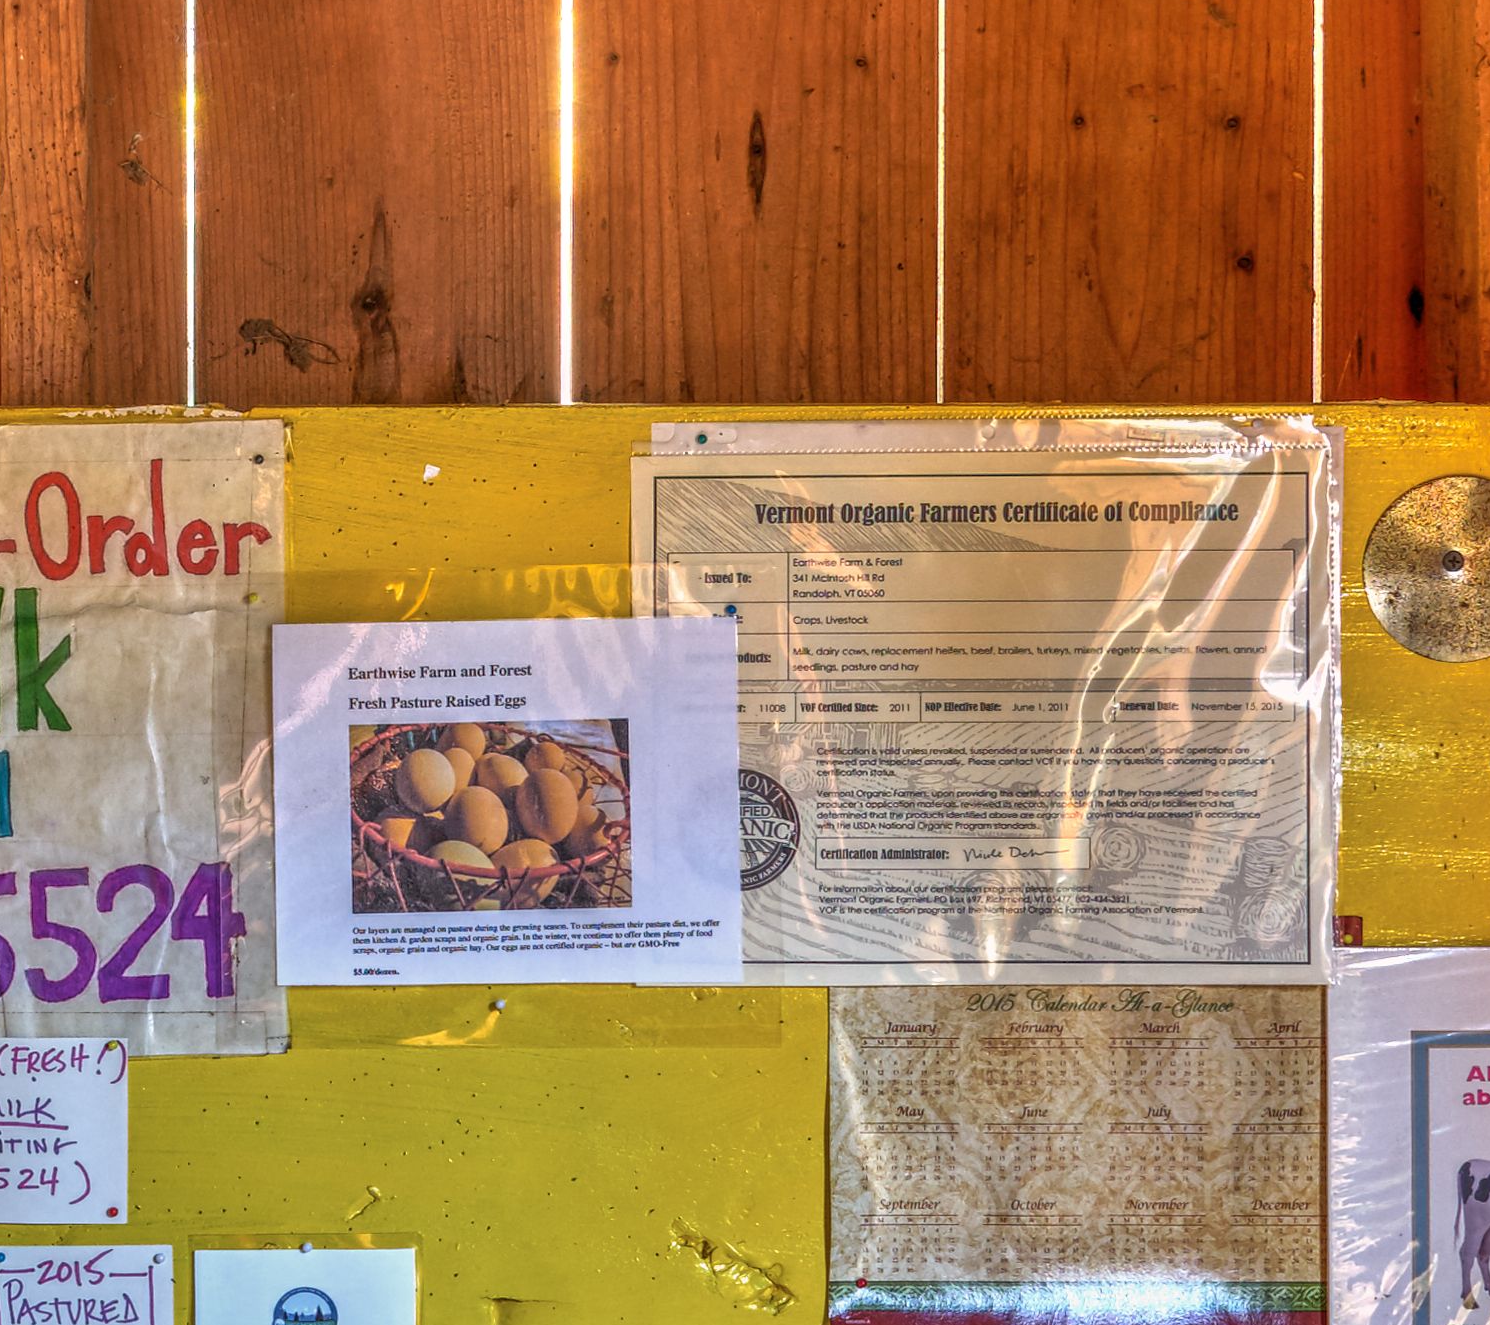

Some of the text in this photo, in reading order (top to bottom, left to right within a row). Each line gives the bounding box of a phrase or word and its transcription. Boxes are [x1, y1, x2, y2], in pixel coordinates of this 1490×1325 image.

[754, 500, 1239, 526] Vermont Organic Farmers Certificate of Compliance
[348, 664, 532, 680] Earthwise Farm and Forest
[348, 694, 527, 711] Fresh Pasture Raised Eggs
[36, 1249, 114, 1285] 2015
[3, 1279, 139, 1325] PASTURED
